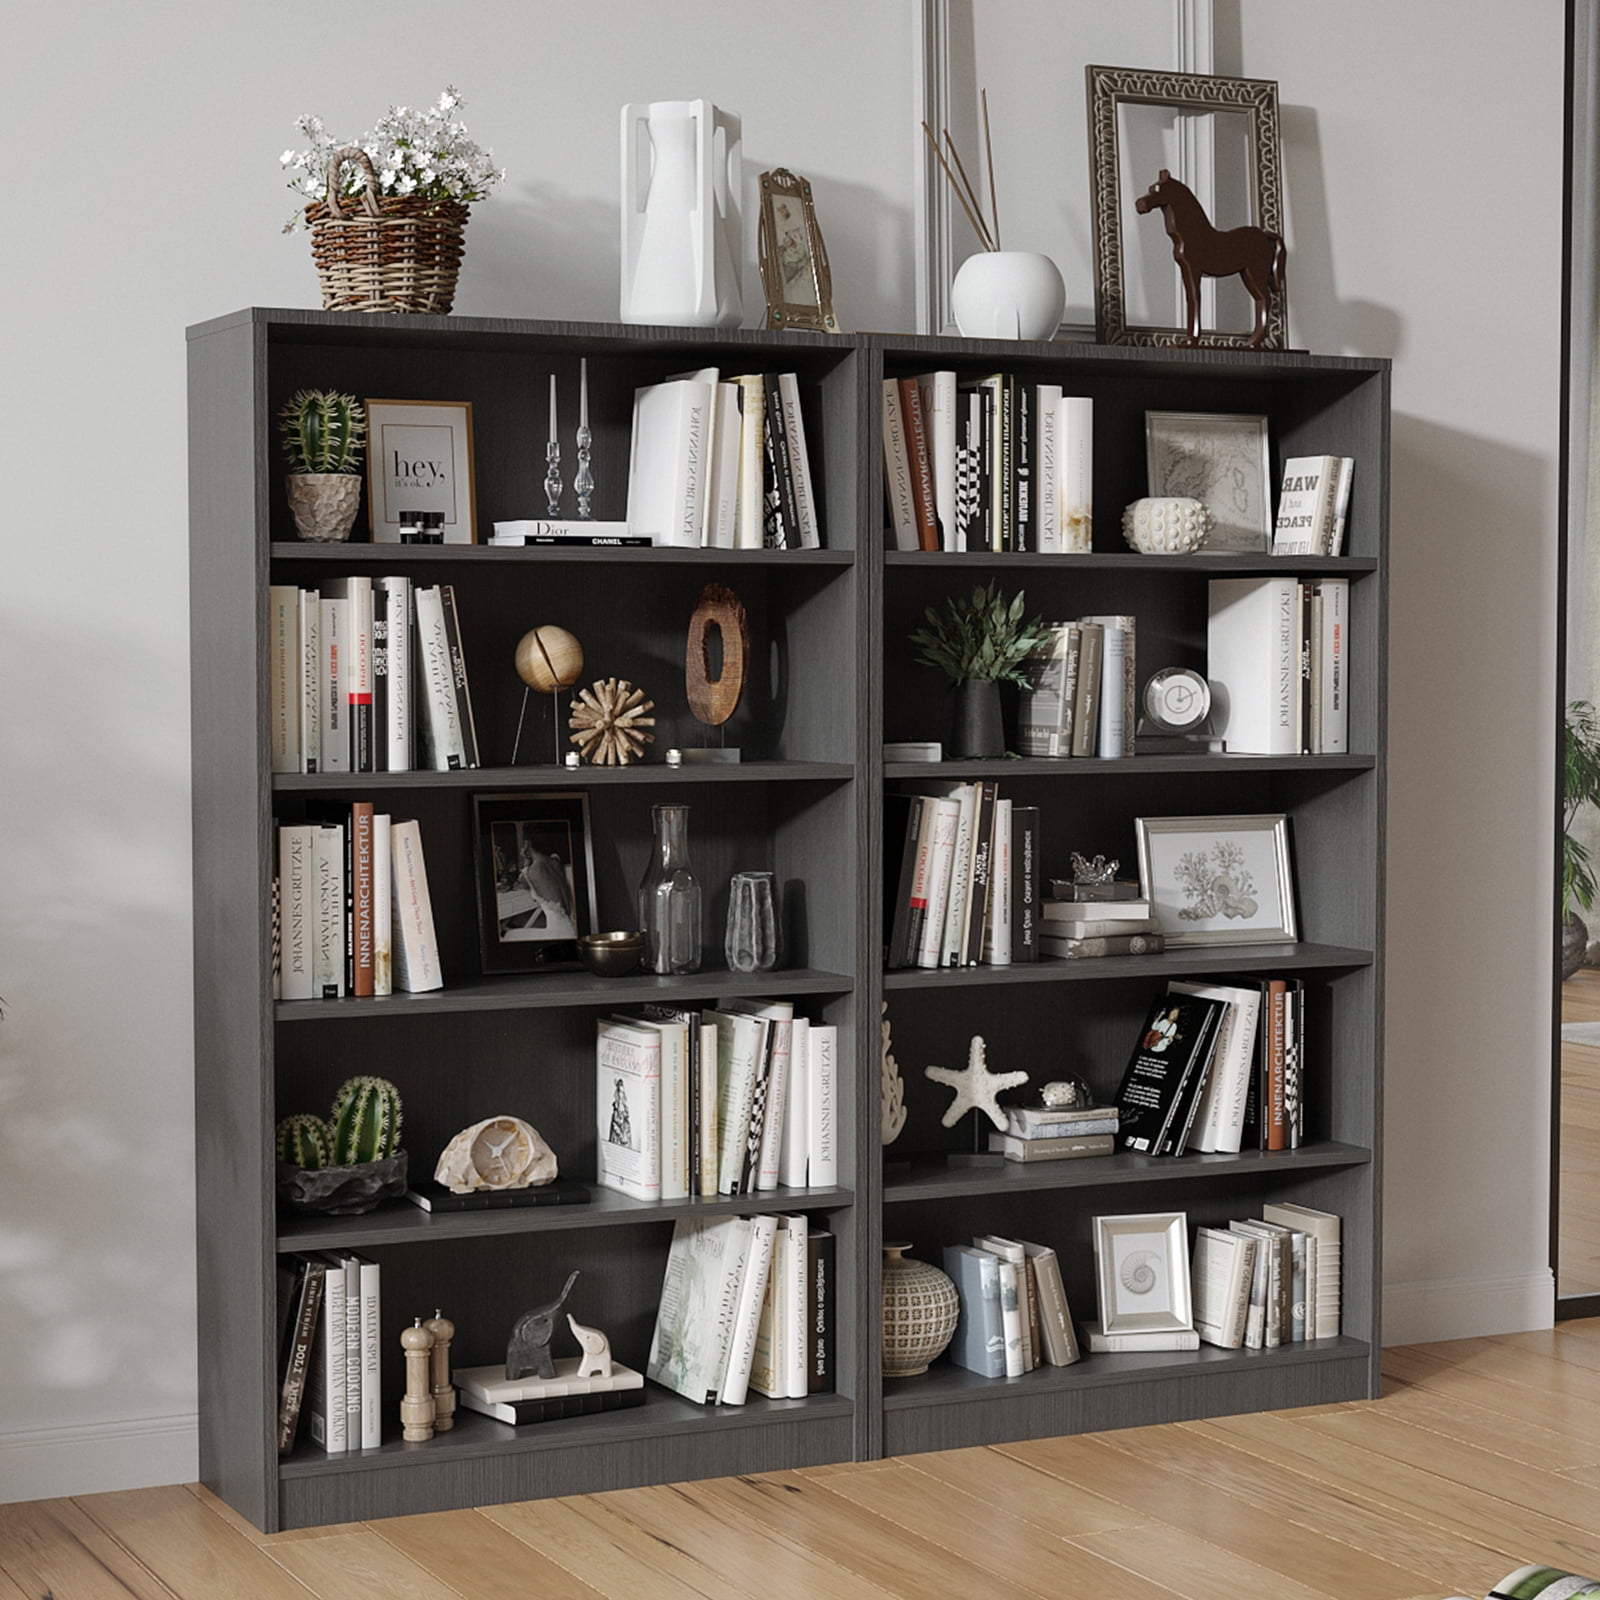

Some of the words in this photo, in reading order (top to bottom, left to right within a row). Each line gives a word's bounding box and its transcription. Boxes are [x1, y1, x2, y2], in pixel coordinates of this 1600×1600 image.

[393, 449, 445, 487] hey,
[536, 522, 569, 536] Dior
[360, 814, 369, 968] INNENARCHITEKTUR
[293, 903, 303, 974] JOHANNES
[1274, 991, 1284, 1126] INNENARCHITEKTUR
[332, 1283, 344, 1347] VEGETARIAN
[347, 1296, 360, 1350] MODERN
[293, 1344, 307, 1374] DOLI
[332, 1353, 343, 1389] INDIAN
[286, 1380, 300, 1412] AMET
[347, 1357, 361, 1413] COOKING
[332, 1394, 344, 1442] COOKING
